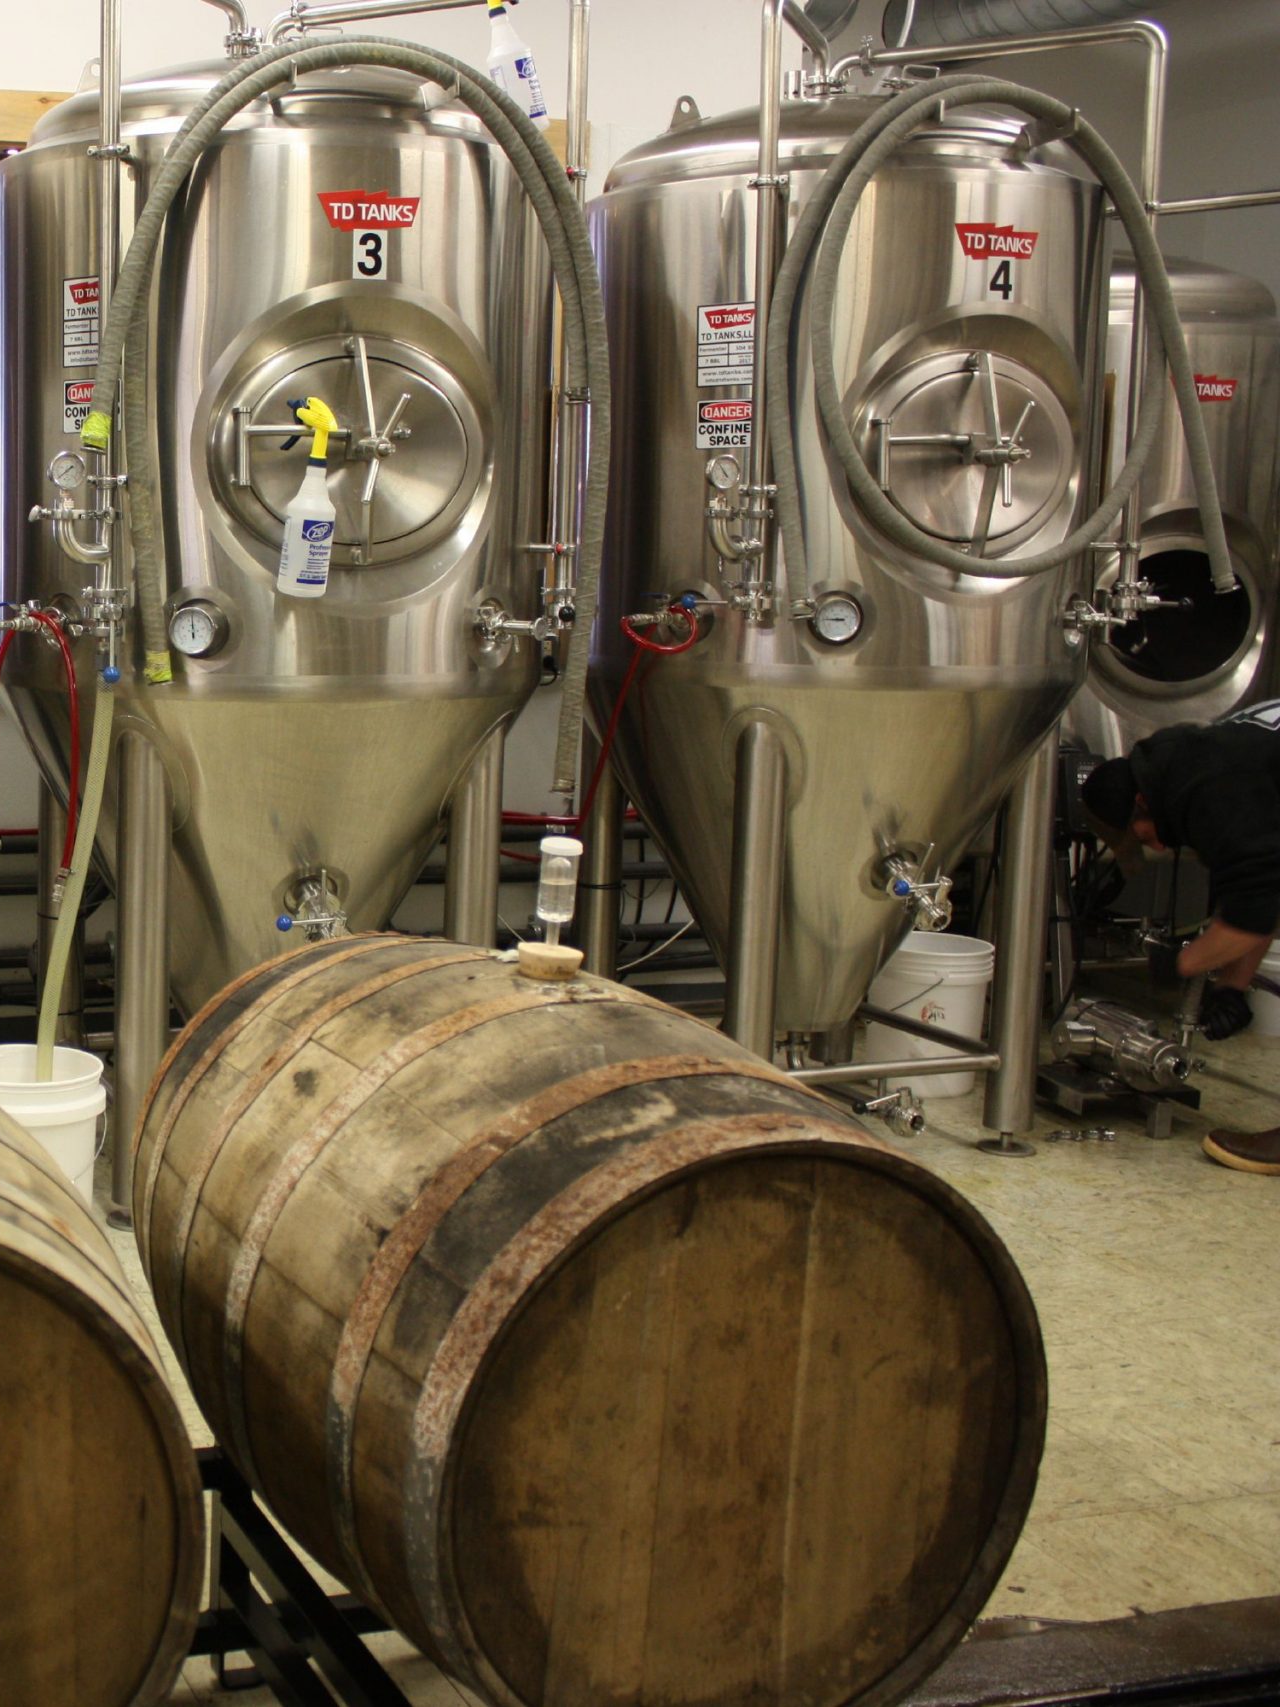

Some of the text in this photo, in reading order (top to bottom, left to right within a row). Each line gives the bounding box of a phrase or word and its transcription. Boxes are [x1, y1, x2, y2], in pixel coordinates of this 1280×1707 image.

[329, 202, 414, 222] TD TANKS
[964, 232, 1033, 255] TD TANKS
[357, 232, 383, 277] 3
[989, 260, 1013, 300] 4
[73, 289, 85, 299] TD
[66, 306, 98, 317] TD TANK
[710, 312, 752, 324] TD TANKS
[701, 329, 754, 341] TD TANKS,LL
[1197, 383, 1233, 398] TANKS
[704, 405, 752, 418] DANGER
[699, 423, 751, 435] CONFINE
[709, 435, 747, 446] SPACE
